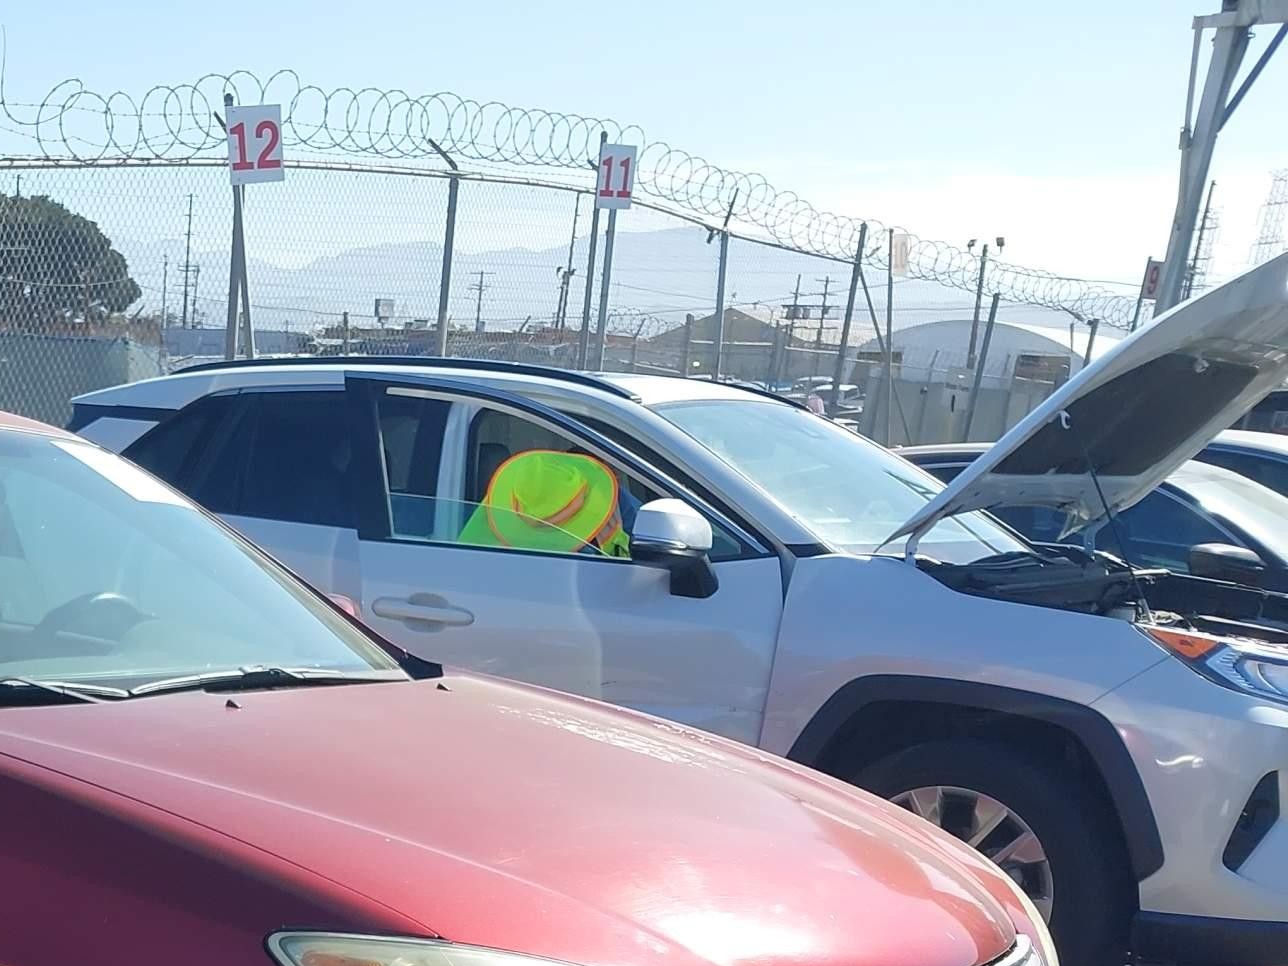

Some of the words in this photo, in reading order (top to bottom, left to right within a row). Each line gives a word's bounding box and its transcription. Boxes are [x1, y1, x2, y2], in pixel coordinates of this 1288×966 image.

[229, 120, 281, 171] 12
[599, 155, 631, 198] 11
[1147, 265, 1161, 295] 9
